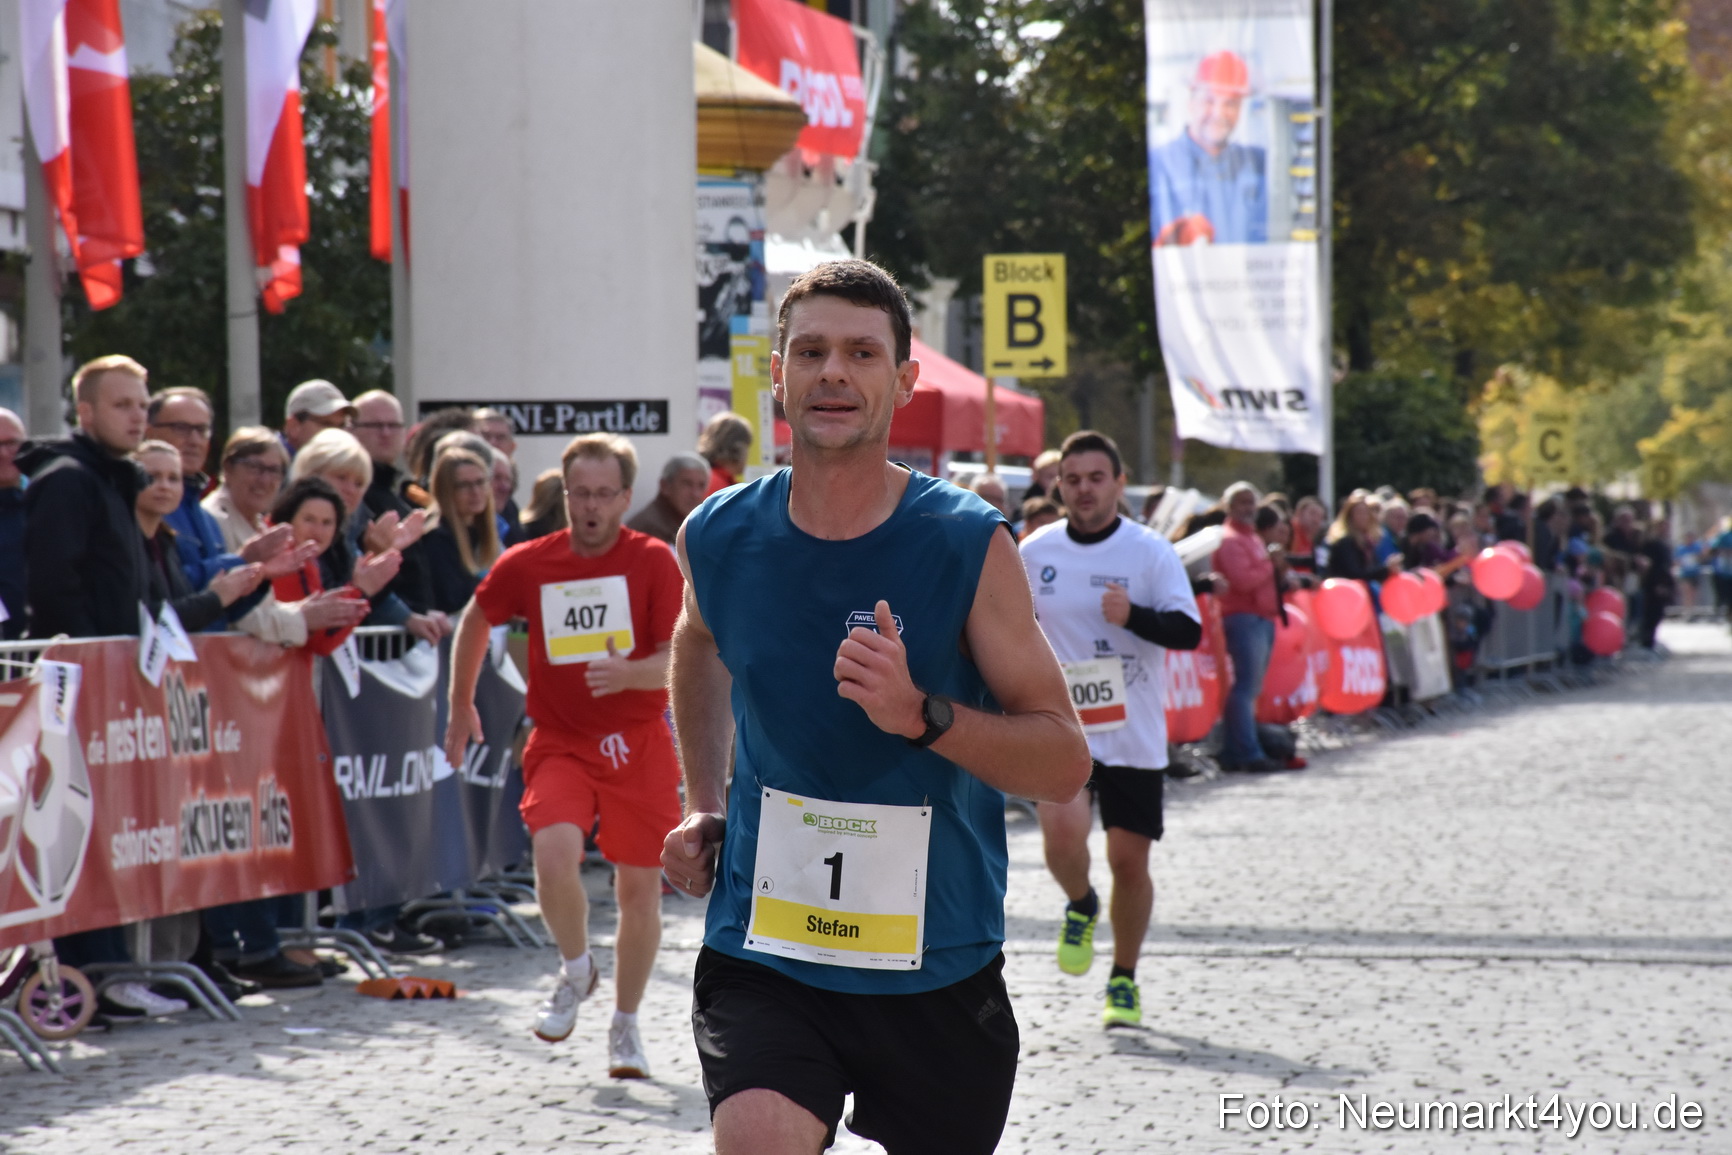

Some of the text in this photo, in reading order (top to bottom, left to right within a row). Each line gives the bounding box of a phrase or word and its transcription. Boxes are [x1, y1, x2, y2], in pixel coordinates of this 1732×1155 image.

[994, 261, 1055, 283] Block
[1006, 293, 1044, 349] B
[1539, 429, 1562, 461] C
[564, 604, 607, 630] 407
[1072, 680, 1113, 704] 005
[335, 751, 434, 800] RAIL.ON
[819, 815, 877, 833] BOCK
[762, 881, 769, 890] A
[823, 852, 843, 900] 1
[806, 915, 860, 938] Stefan
